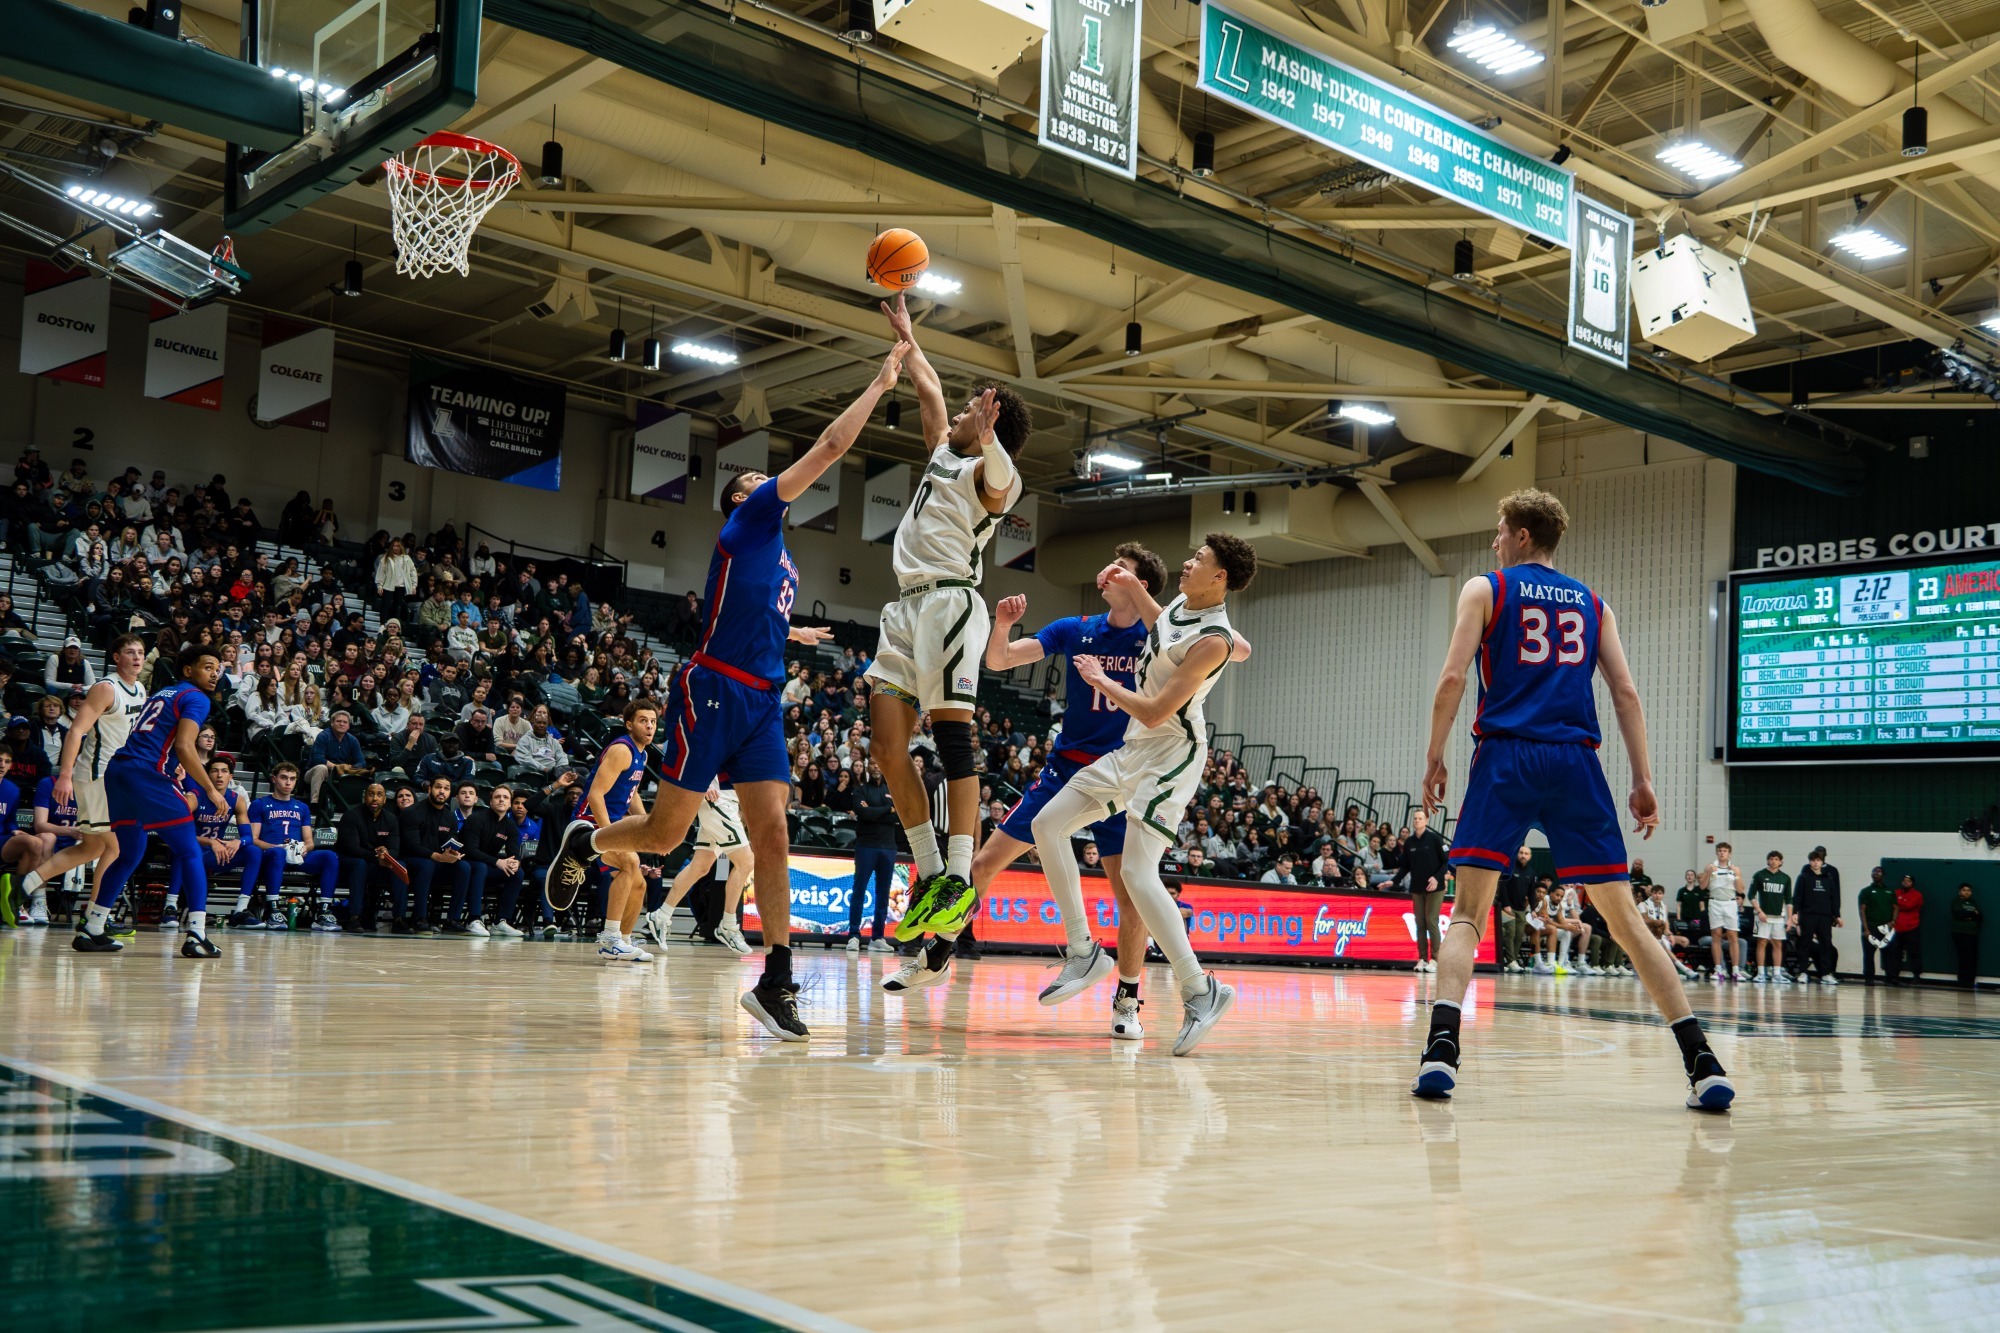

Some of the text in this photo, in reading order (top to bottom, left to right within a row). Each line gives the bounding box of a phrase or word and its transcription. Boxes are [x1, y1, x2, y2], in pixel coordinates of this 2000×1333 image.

[1081, 14, 1104, 76] 1
[1215, 21, 1250, 93] L
[1070, 71, 1112, 99] COACH,
[1064, 84, 1117, 117] ATHLETIC
[1063, 100, 1119, 134] DIRECTOR
[1262, 46, 1563, 200] MASON-DIXON CONFERENCE CHAMPIONS
[1051, 118, 1127, 161] 1938-1973
[1261, 79, 1562, 226] 1942 1947 1948 1949 1953 1971 1973
[1586, 209, 1620, 233] JIM LACY
[1593, 269, 1609, 293] 16
[37, 313, 95, 334] BOSTON
[154, 338, 218, 361] BUCKNELL
[270, 364, 323, 383] COLGATE
[430, 385, 550, 426] TEAMING UP!
[491, 420, 544, 438] LIFEBRIDGE
[491, 428, 530, 443] HEALTH
[72, 427, 94, 451] 2
[490, 440, 542, 457] CARE BRAVELY
[636, 444, 686, 462] HOLY CROSS
[388, 481, 405, 501] 3
[914, 481, 932, 519] 0
[872, 495, 901, 508] LOYOLA
[651, 530, 666, 548] 4
[1757, 537, 1876, 568] FORBES
[840, 568, 851, 585] 5
[776, 577, 795, 623] 32
[1520, 582, 1585, 605] MAYOCK
[1742, 595, 1807, 613] LOYOLA
[1814, 587, 1833, 609] 33
[1854, 577, 1891, 602] 2:12
[1919, 578, 1938, 600] 23
[1858, 612, 1889, 621] POSSESSION
[1955, 603, 1961, 612] 4
[1833, 613, 1838, 622] 4
[1518, 604, 1586, 667] 33
[1745, 648, 1869, 666] 0 SPEED 10 1 1 0
[1879, 641, 1986, 657] 3 HOGANS 0 0
[1744, 672, 1747, 681] 1
[1820, 667, 1824, 677] 4
[1835, 666, 1839, 676] 4
[1850, 665, 1854, 675] 3
[1867, 665, 1869, 674] 1
[1879, 658, 1986, 673] 12 SPROUSE 0 1
[1820, 683, 1824, 693] 0
[1836, 682, 1840, 692] 2
[1850, 681, 1854, 691] 0
[1865, 681, 1869, 690] 0
[1879, 675, 1986, 690] 16 BROWN 0 0
[1744, 697, 1869, 712] 22 SPRINGER 2 0 1 1
[1878, 691, 1986, 706] 32 ITURBE 3 3
[1743, 718, 1752, 727] 24
[1819, 715, 1824, 725] 0
[1837, 714, 1840, 724] 1
[1849, 713, 1854, 723] 0
[1865, 713, 1869, 723] 0
[1878, 709, 1986, 722] 33 MAYOCK 9 3
[1857, 729, 1861, 740] 3
[1951, 726, 1960, 737] 17
[268, 810, 301, 820] AMERICAN
[200, 826, 221, 840] 23
[281, 820, 290, 836] 7
[989, 897, 1029, 923] us
[1313, 905, 1334, 942] for
[1335, 906, 1372, 957] you!
